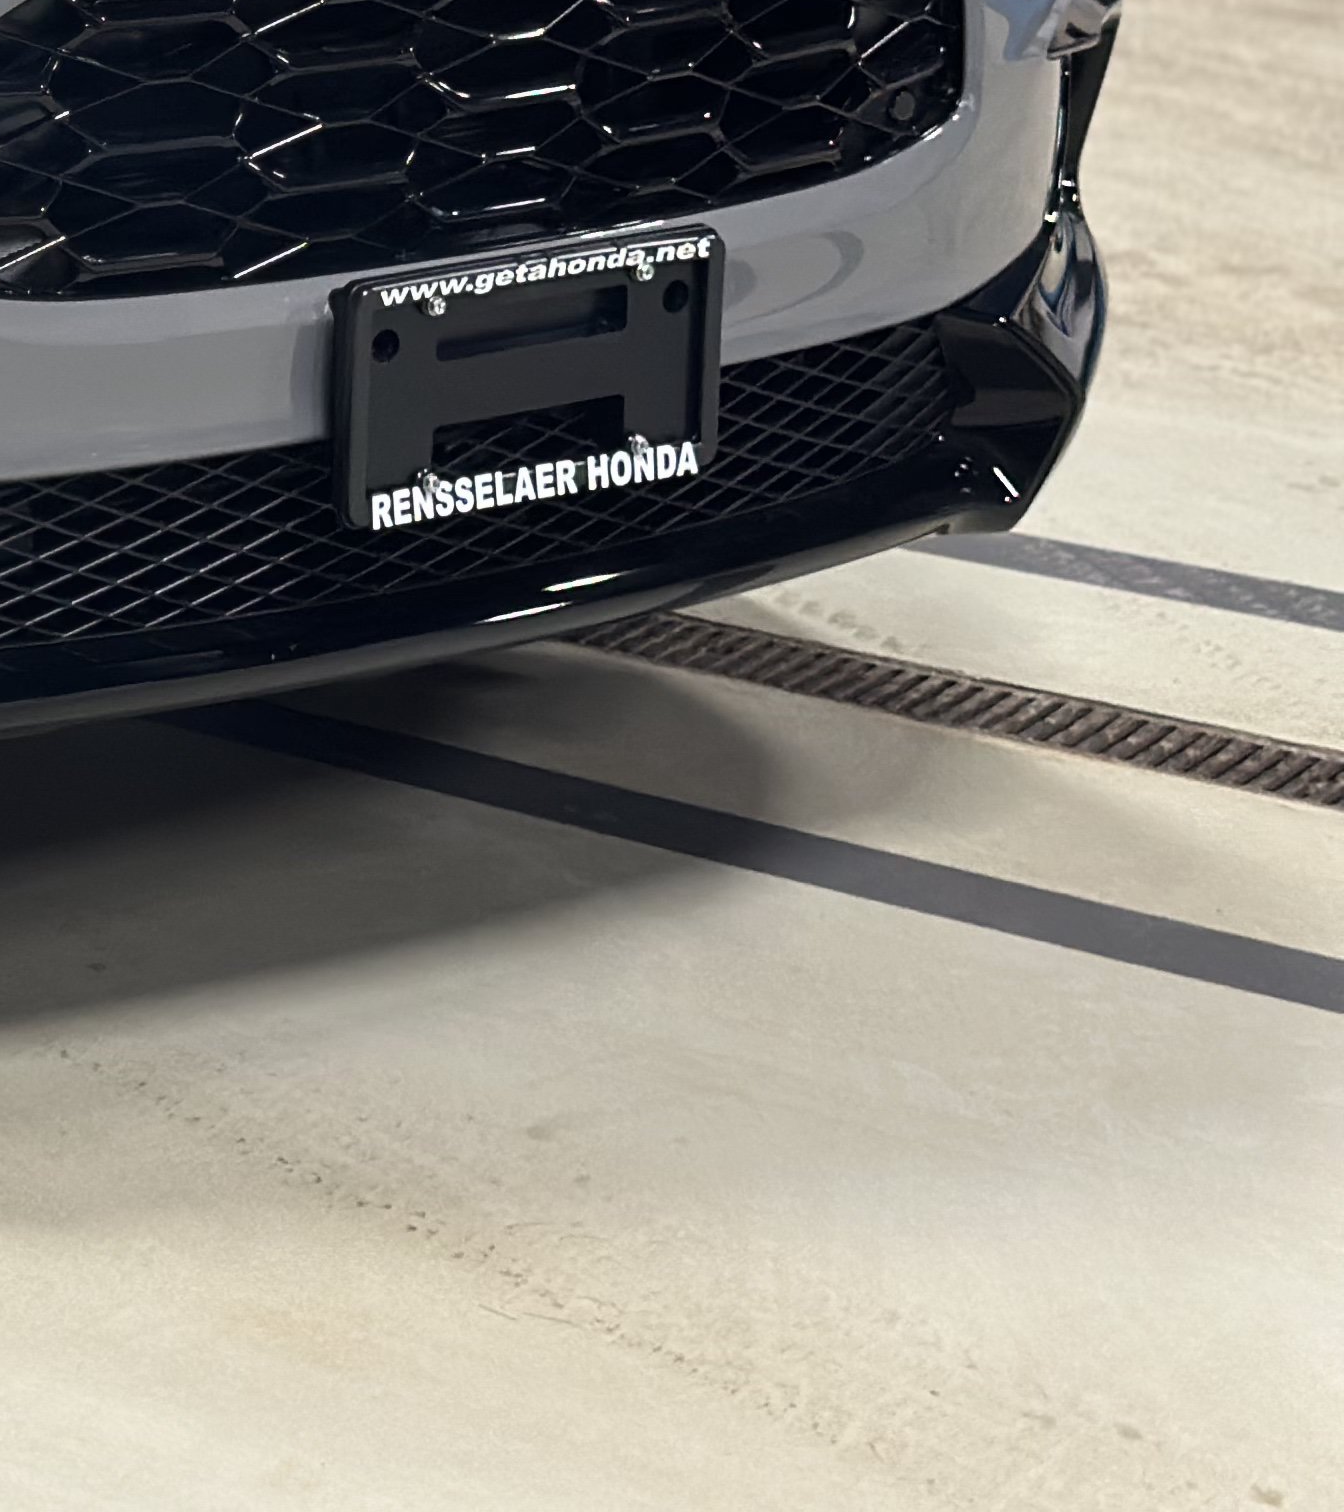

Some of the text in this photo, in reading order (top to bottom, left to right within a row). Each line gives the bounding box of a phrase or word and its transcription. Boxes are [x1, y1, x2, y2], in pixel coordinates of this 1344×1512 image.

[380, 238, 711, 306] www.getahonda.net
[372, 441, 698, 530] RENSSELAER HONDA
